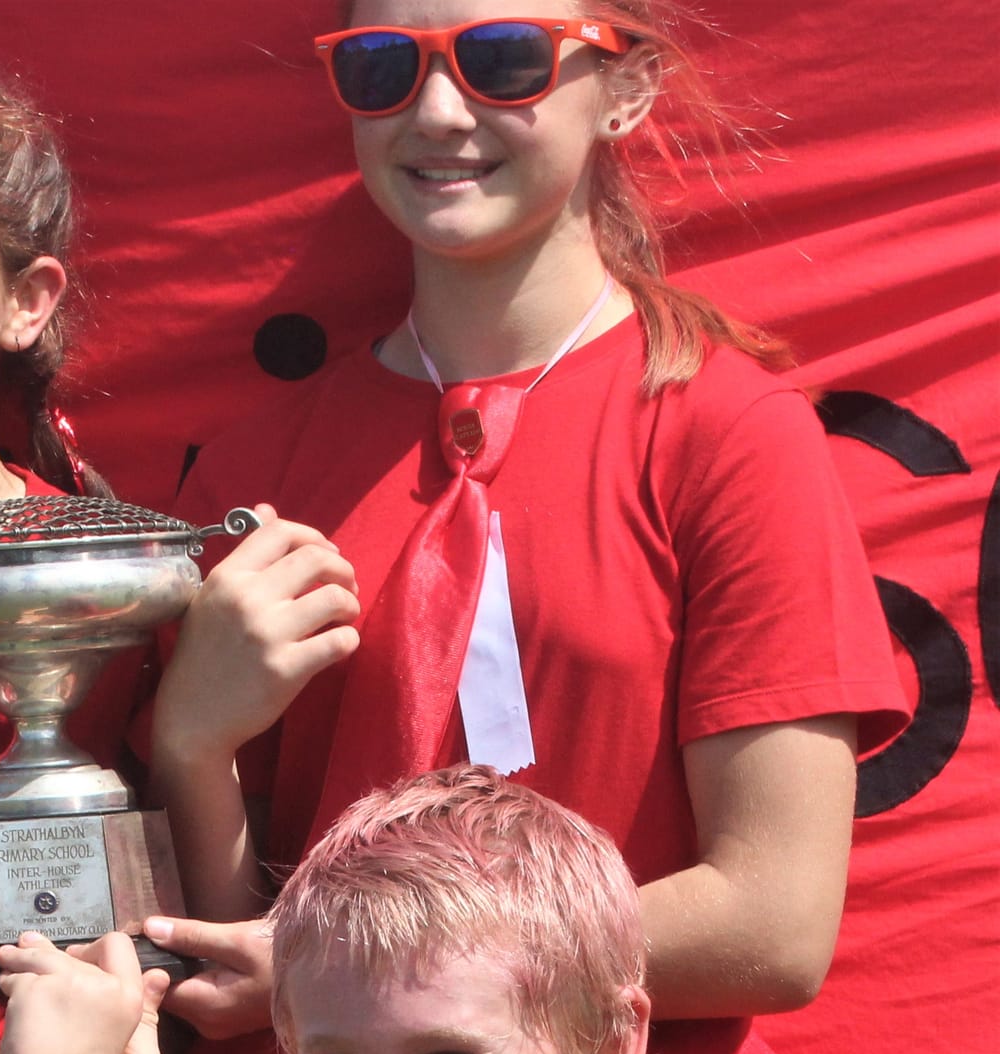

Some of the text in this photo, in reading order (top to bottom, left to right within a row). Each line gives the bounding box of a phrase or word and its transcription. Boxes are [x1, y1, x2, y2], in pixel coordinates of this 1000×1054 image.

[1, 826, 85, 843] STRATHALBYN
[48, 844, 95, 860] SCHOOL
[7, 863, 82, 879] INTER-HOUSE
[17, 878, 73, 891] ATHLETICS
[56, 924, 87, 937] ROTARY
